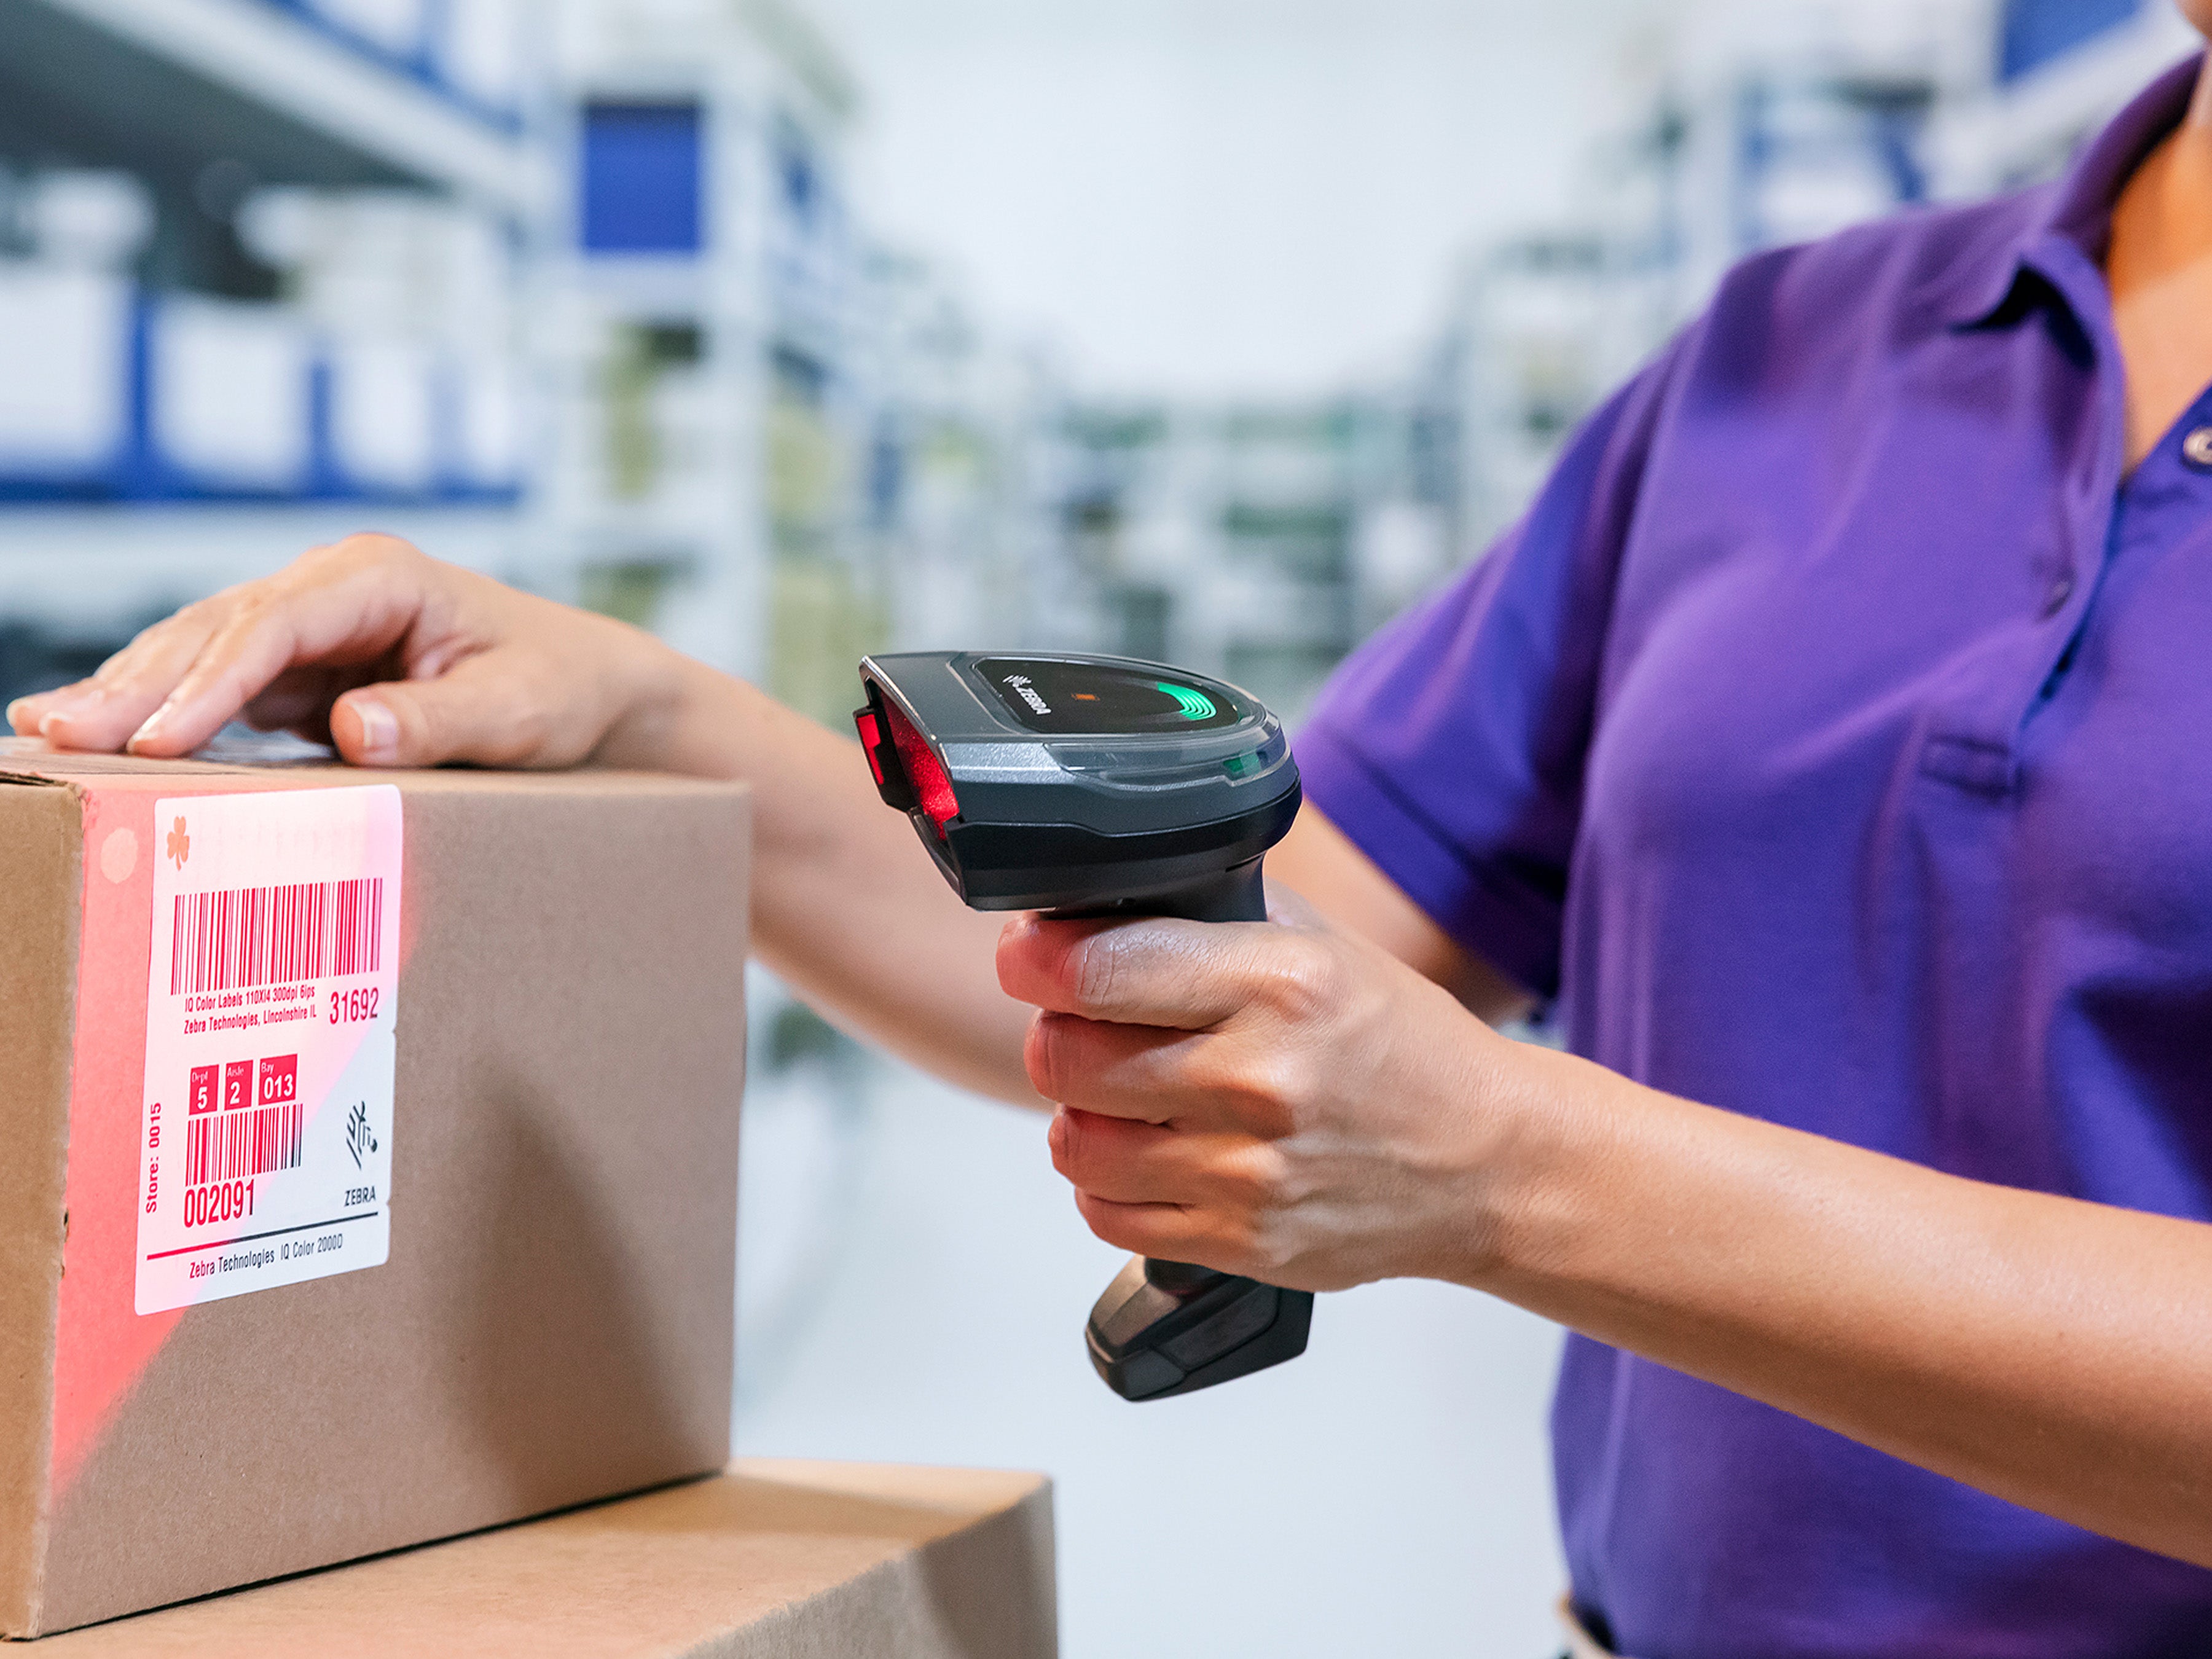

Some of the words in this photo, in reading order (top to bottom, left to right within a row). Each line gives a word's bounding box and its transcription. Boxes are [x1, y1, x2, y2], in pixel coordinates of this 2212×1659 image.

[1016, 687, 1052, 715] ZEBRA
[185, 994, 194, 1012] IQ
[196, 993, 216, 1011] Color
[218, 992, 243, 1008] Labels
[273, 986, 297, 1003] 300dpi
[329, 987, 379, 1024] 31692
[184, 1019, 206, 1034] Zebra
[209, 1012, 261, 1030] Technologies,
[264, 1006, 307, 1024] Lincolnshire
[310, 1004, 316, 1018] IL
[261, 1062, 274, 1075] Bay
[197, 1086, 207, 1109] 5
[230, 1082, 240, 1104] 2
[264, 1074, 293, 1099] 013
[149, 1102, 162, 1148] 0015
[146, 1156, 159, 1214] Store:
[344, 1186, 376, 1207] ZEBRA
[184, 1179, 254, 1228] 002091
[189, 1260, 215, 1279] Zebra
[218, 1249, 275, 1272] Technologies
[280, 1242, 290, 1260] IQ
[293, 1241, 314, 1258] Color
